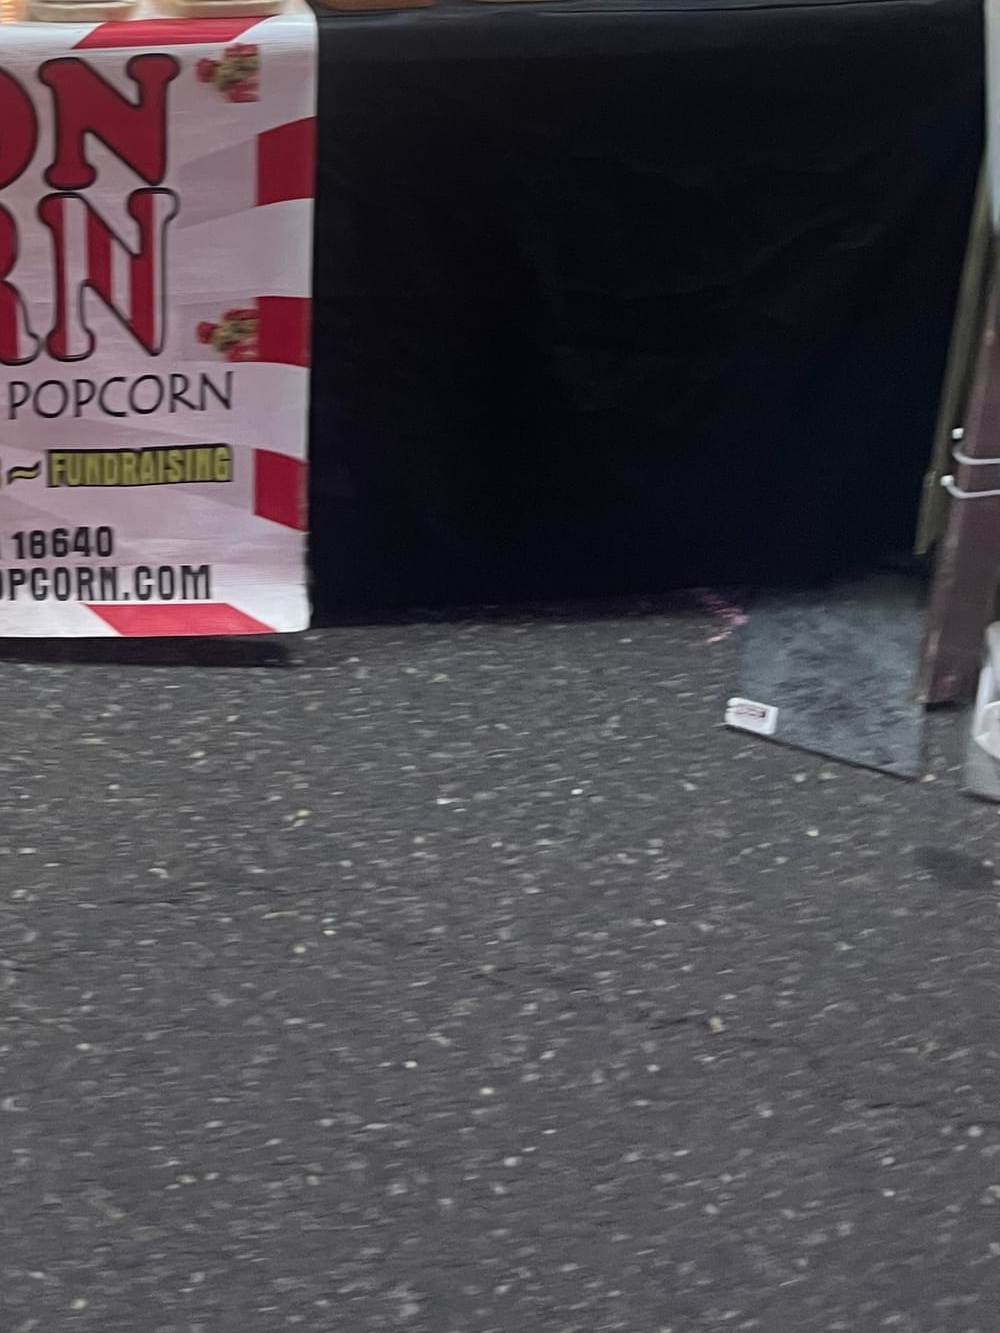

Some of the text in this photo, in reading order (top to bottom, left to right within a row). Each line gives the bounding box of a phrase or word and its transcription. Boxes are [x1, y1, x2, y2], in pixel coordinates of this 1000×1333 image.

[8, 371, 234, 420] POPCORN
[46, 443, 234, 488] FUNDRAISING
[12, 525, 115, 559] 18640
